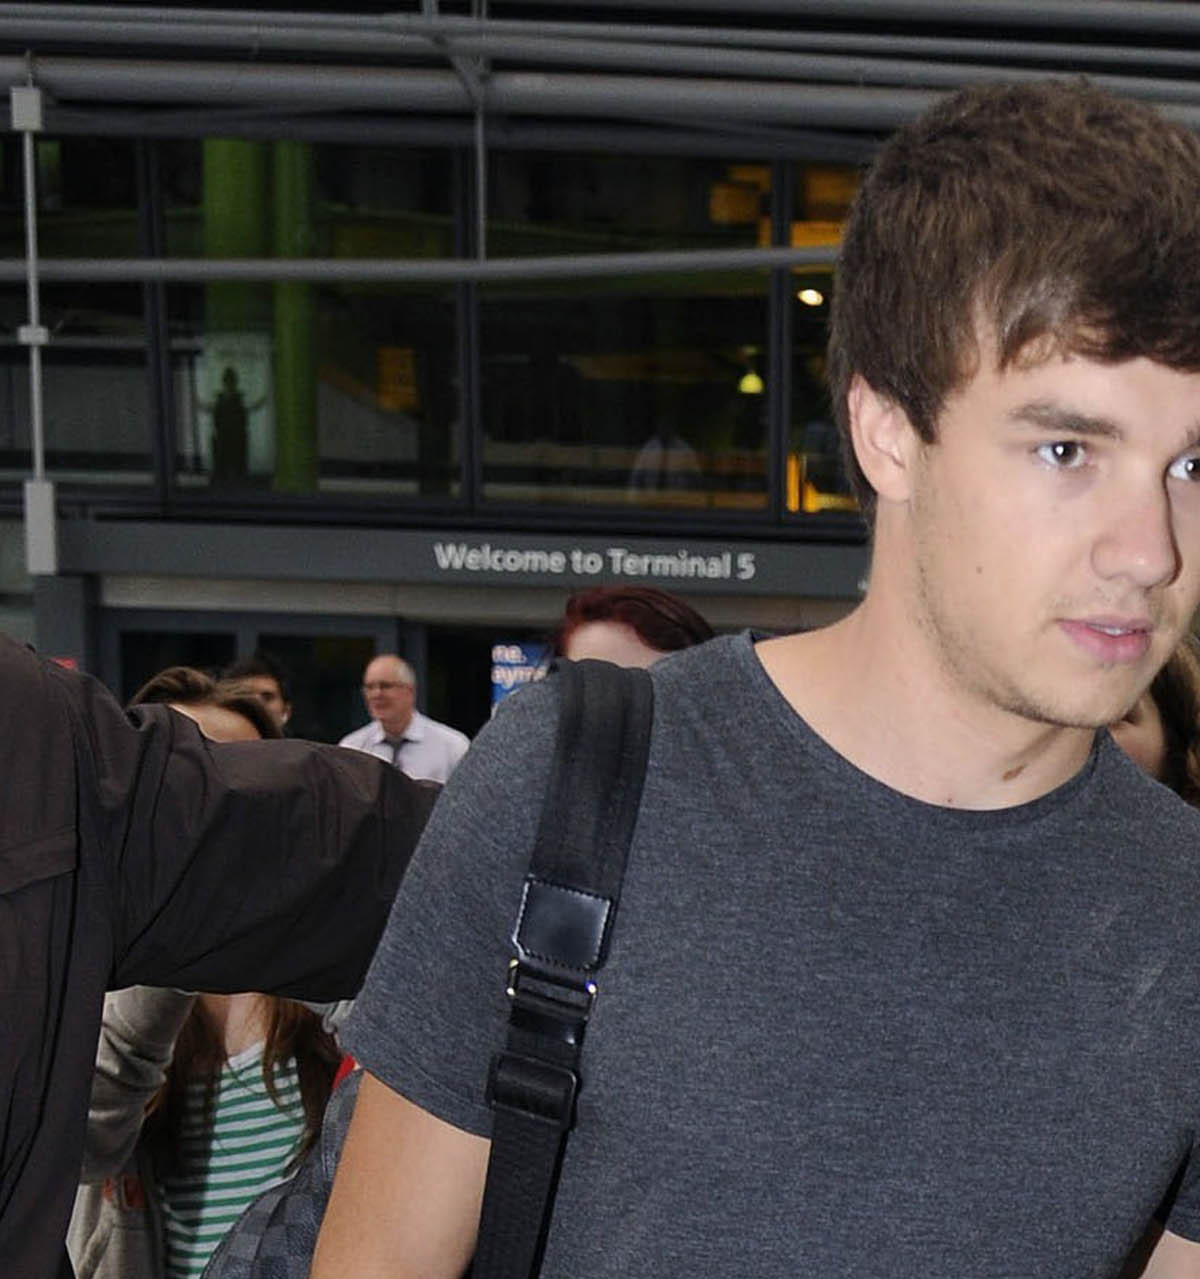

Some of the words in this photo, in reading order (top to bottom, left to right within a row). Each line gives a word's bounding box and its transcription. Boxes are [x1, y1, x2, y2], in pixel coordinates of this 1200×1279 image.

[434, 543, 566, 573] Welcome
[571, 549, 603, 574] to
[606, 548, 731, 578] Terminal
[736, 552, 756, 580] 5
